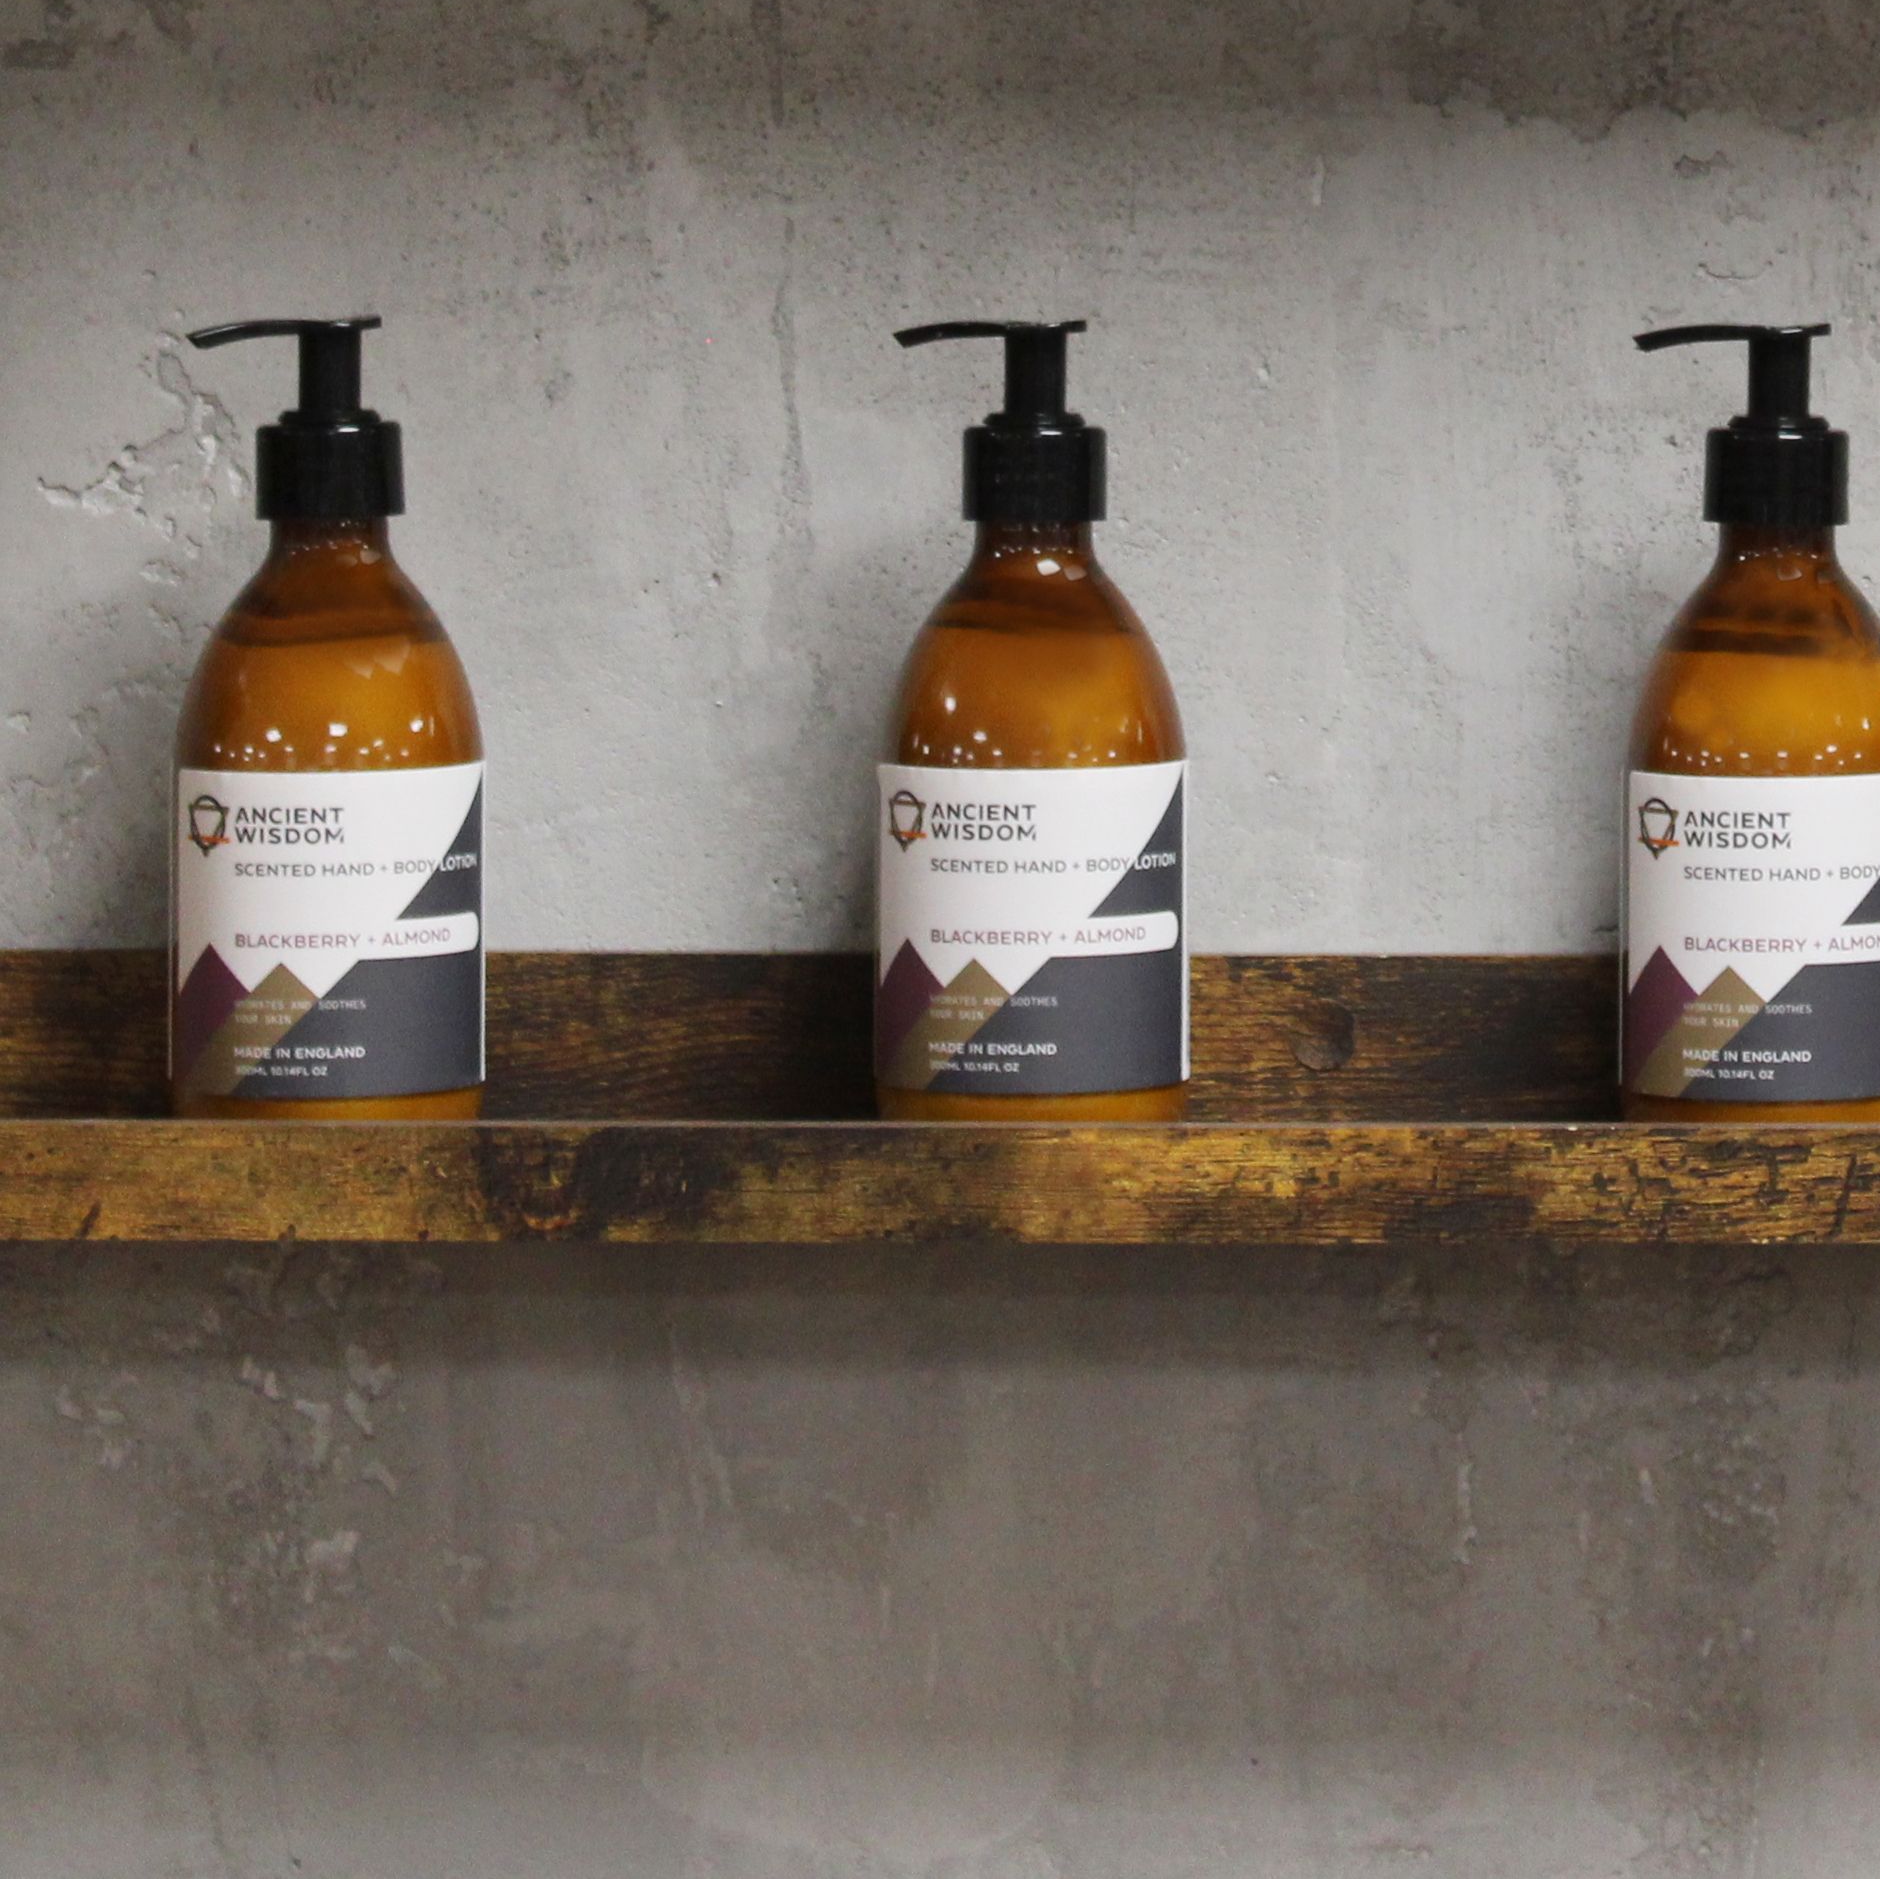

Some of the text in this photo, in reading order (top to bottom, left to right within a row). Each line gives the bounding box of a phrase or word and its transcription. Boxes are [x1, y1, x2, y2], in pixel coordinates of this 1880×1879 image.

[235, 807, 344, 825] ANCIENT
[931, 803, 1036, 821] ANCIENT
[1685, 811, 1791, 829] ANCIENT
[235, 827, 344, 845] WISDOM
[931, 823, 1036, 841] WISDOM
[1685, 832, 1791, 849] WISDOM
[235, 864, 315, 877] SCENTED
[322, 863, 374, 877] HAND
[394, 860, 437, 874] BODY
[931, 858, 1007, 873] SCENTED
[1015, 860, 1066, 873] HAND
[1087, 858, 1131, 872] BODY
[1684, 866, 1763, 881] SCENTED
[1770, 868, 1820, 881] HAND
[235, 934, 360, 948] BLACKBERRY
[383, 929, 451, 946] ALMOND
[931, 929, 1051, 945] BLACKBERRY
[1074, 927, 1146, 943] ALMOND
[1685, 937, 1807, 952] BLACKBERRY
[234, 1047, 365, 1059] MADE IN ENGLAND
[929, 1043, 1057, 1055] MADE IN ENGLAND
[1682, 1050, 1812, 1063] MADE IN ENGLAND
